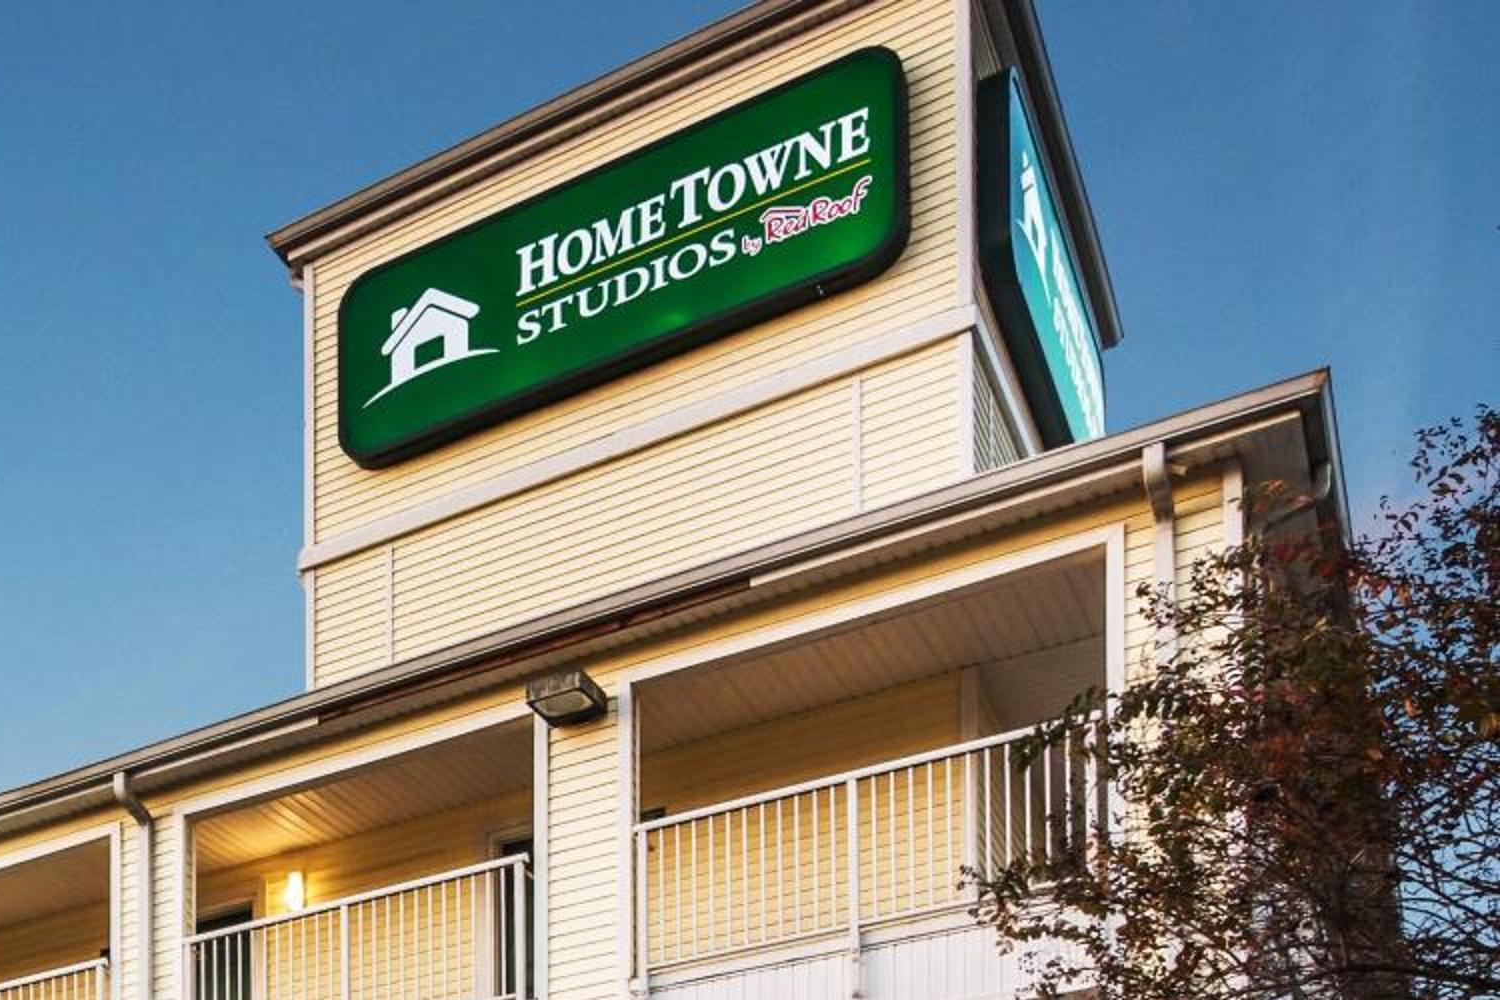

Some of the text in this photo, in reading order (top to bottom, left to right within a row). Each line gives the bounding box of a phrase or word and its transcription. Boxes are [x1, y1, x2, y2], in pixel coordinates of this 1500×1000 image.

[516, 175, 873, 346] STUDIOS by Red Roof
